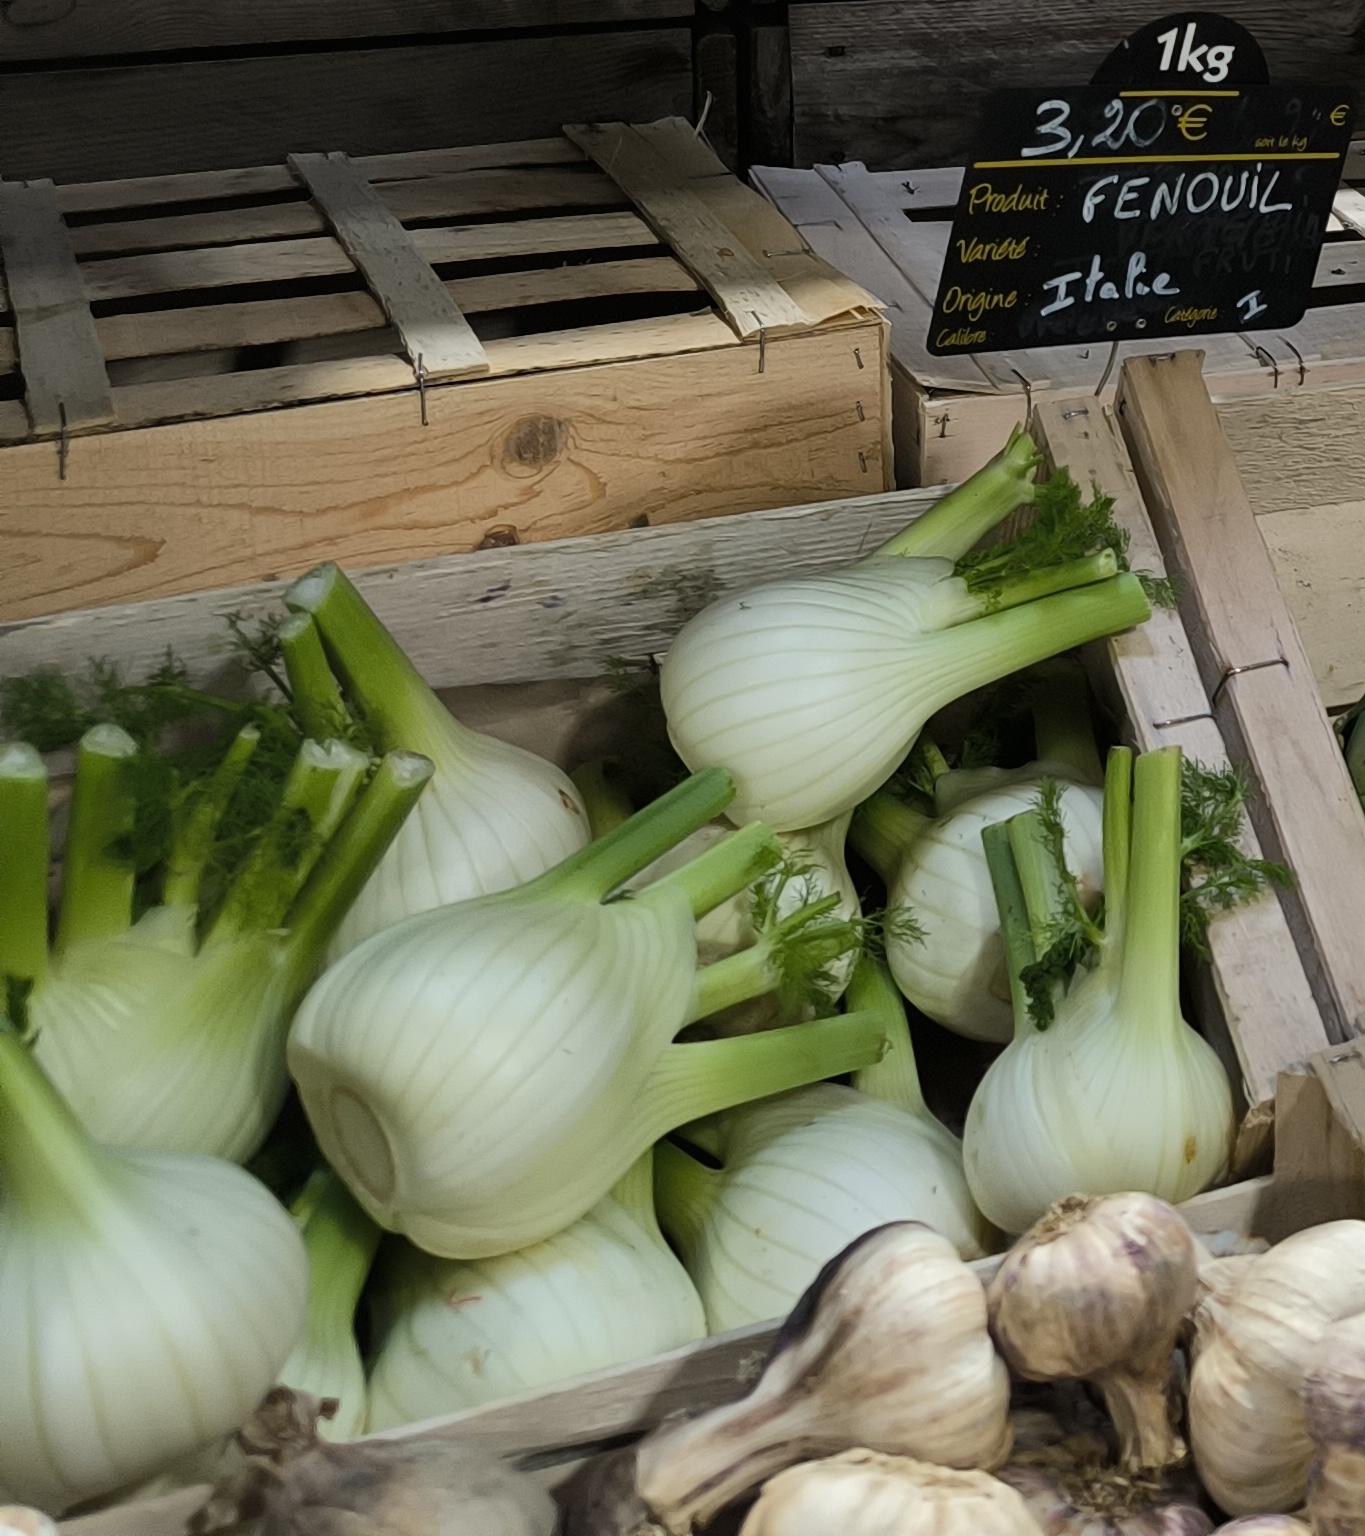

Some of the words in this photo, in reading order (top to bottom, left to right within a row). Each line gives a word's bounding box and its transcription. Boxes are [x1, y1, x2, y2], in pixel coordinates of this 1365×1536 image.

[1157, 22, 1236, 82] 1kg
[1020, 98, 1167, 157] 3,20
[1177, 104, 1213, 141] €
[1330, 104, 1349, 126] €
[1292, 135, 1308, 152] kg
[968, 183, 1049, 215] Produit
[956, 236, 1031, 264] Variété
[943, 285, 1018, 321] Origine
[1039, 250, 1181, 316] Italie
[1164, 304, 1218, 325] Catégorie
[936, 327, 987, 348] Calibre
